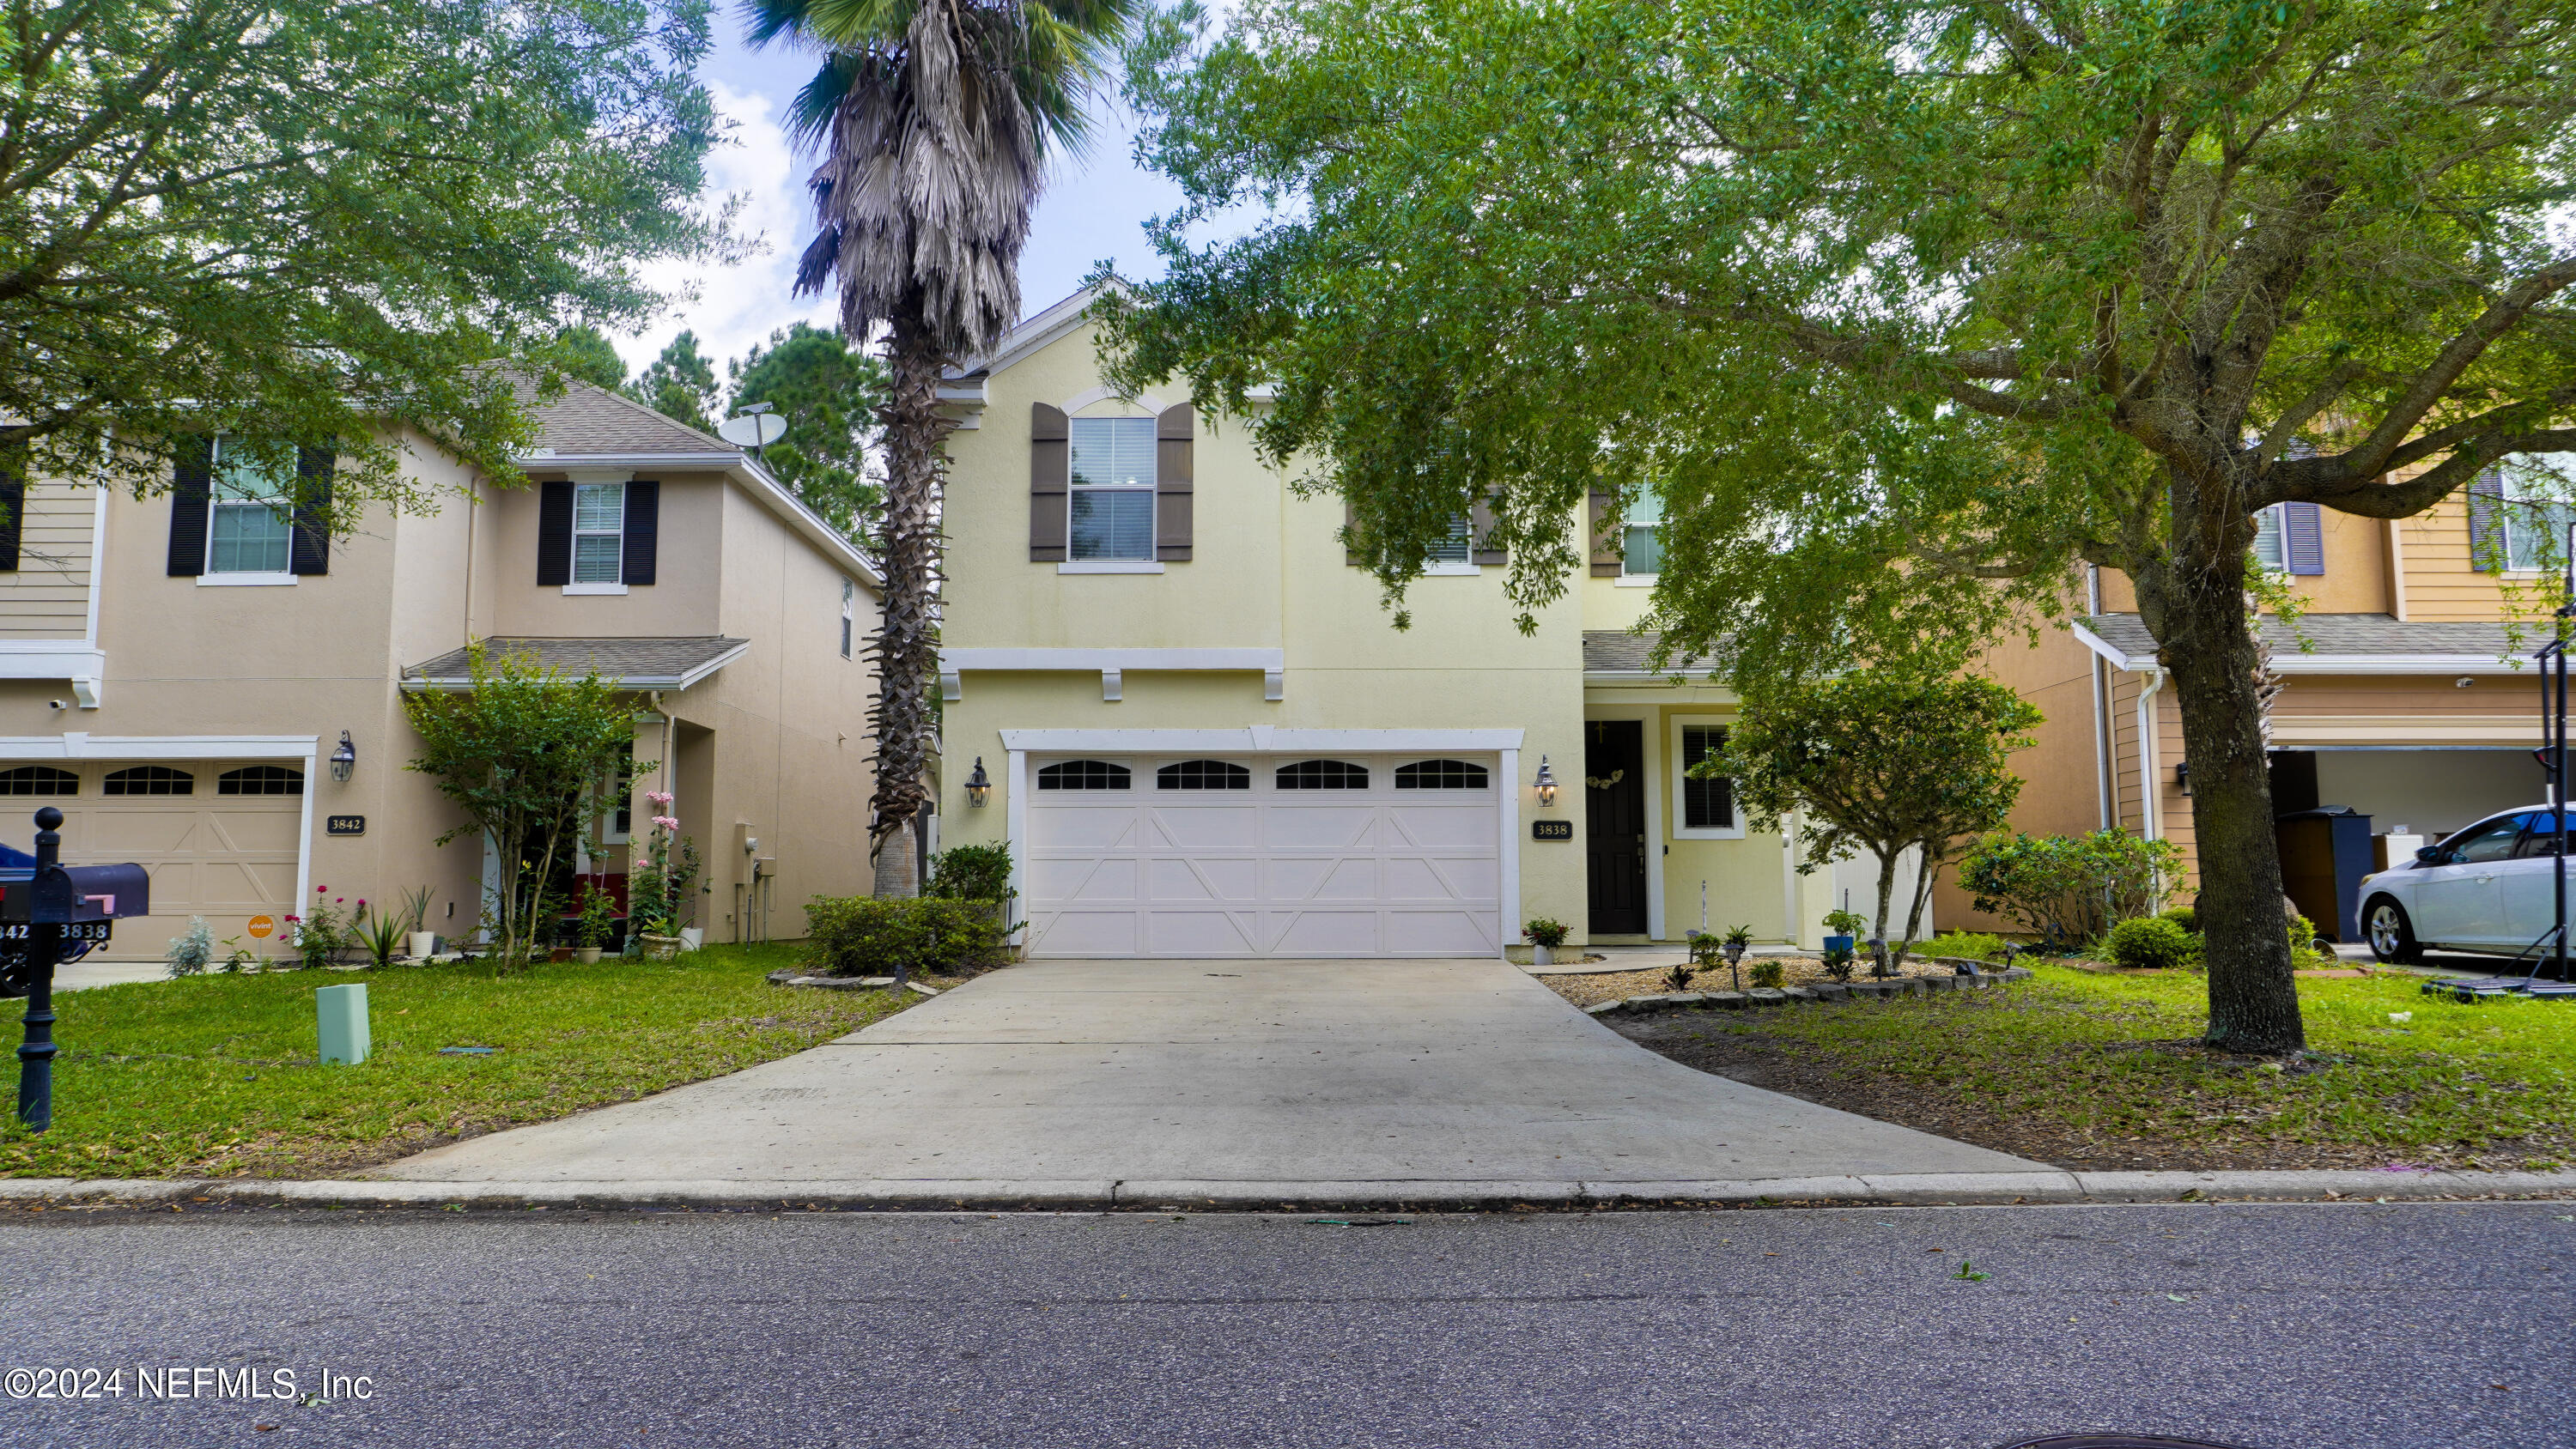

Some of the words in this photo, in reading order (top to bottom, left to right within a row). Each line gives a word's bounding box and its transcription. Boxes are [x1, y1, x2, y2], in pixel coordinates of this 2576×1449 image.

[331, 819, 361, 829] 3842
[1538, 824, 1568, 835] 3838
[59, 924, 107, 939] 3838
